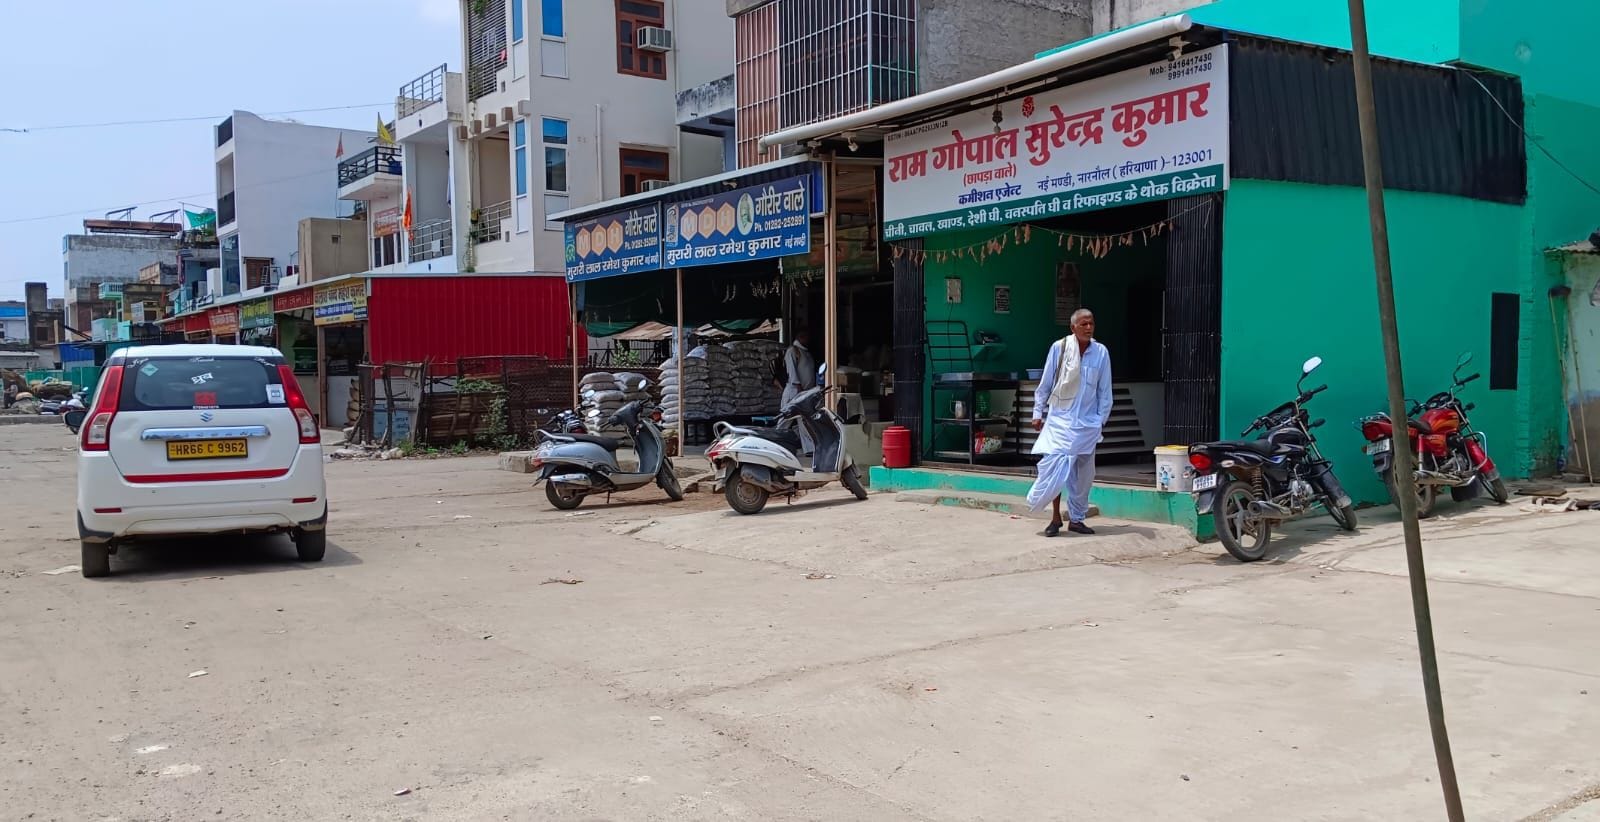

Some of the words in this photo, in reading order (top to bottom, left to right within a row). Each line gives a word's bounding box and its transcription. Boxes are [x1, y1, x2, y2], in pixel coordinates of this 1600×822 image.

[1150, 66, 1166, 76] Mob:
[1168, 62, 1212, 80] 9991417430
[888, 150, 928, 183] राम
[932, 128, 1019, 171] गोपाल
[1024, 104, 1104, 166] सुरेन्द्र
[1111, 82, 1210, 147] कुमार
[994, 161, 1017, 180] वाले)
[1037, 175, 1048, 192] नई
[1077, 166, 1110, 184] नारनौल
[1119, 159, 1157, 177] हरियाणा
[783, 180, 805, 211] वाले
[958, 187, 993, 205] कमीशन
[967, 209, 987, 227] देशी
[1005, 198, 1045, 218] वनस्पति
[1047, 195, 1060, 213] घी
[1062, 199, 1071, 211] व
[1124, 184, 1138, 201] के
[1140, 179, 1169, 198] थोक
[1171, 172, 1217, 194] विक्रेता
[643, 206, 657, 234] वाले
[667, 243, 692, 265] मुरारी
[695, 244, 717, 259] लाल
[719, 239, 745, 255] रमेश
[748, 235, 782, 257] कुमार
[567, 261, 584, 280] मुरारी
[586, 262, 600, 274] लाल
[602, 256, 620, 271] रमेश
[621, 255, 644, 272] कुमार
[175, 443, 203, 456] HR66
[218, 442, 244, 453] 9962
